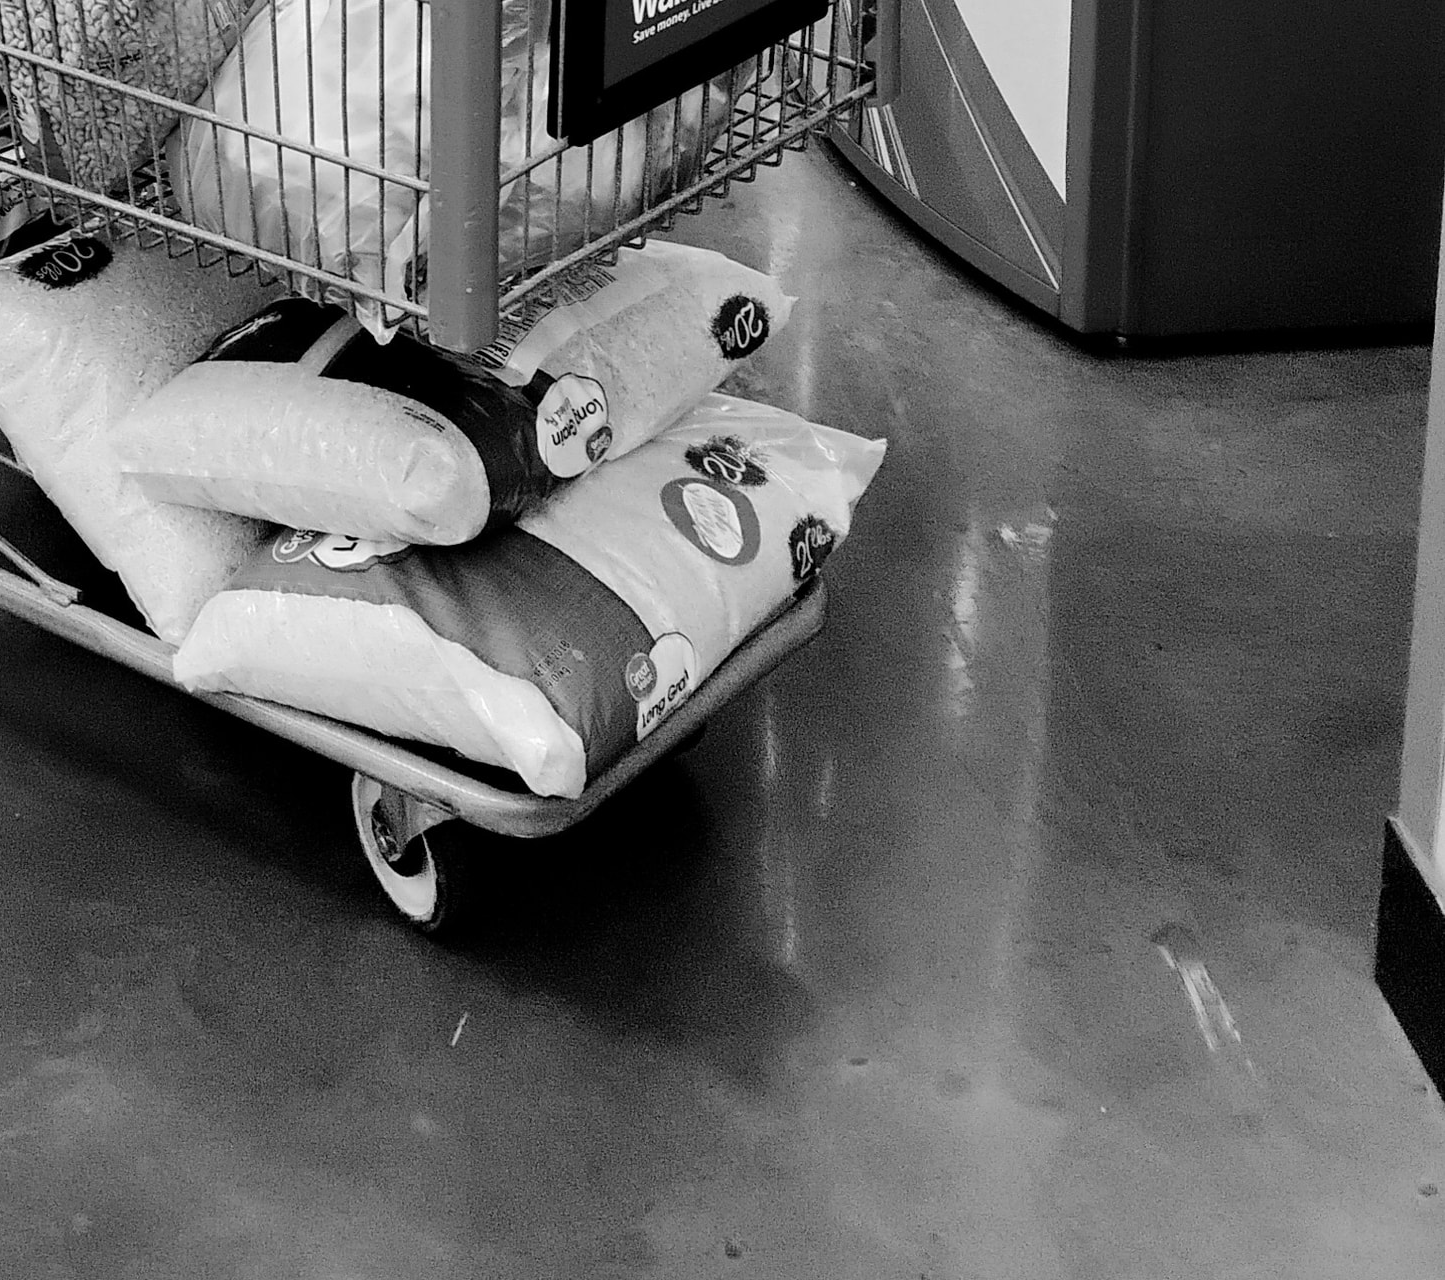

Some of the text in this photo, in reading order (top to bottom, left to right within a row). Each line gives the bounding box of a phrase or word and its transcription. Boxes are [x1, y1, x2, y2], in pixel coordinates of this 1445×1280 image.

[632, 25, 656, 45] Save
[656, 9, 692, 33] money.
[641, 697, 666, 729] Long
